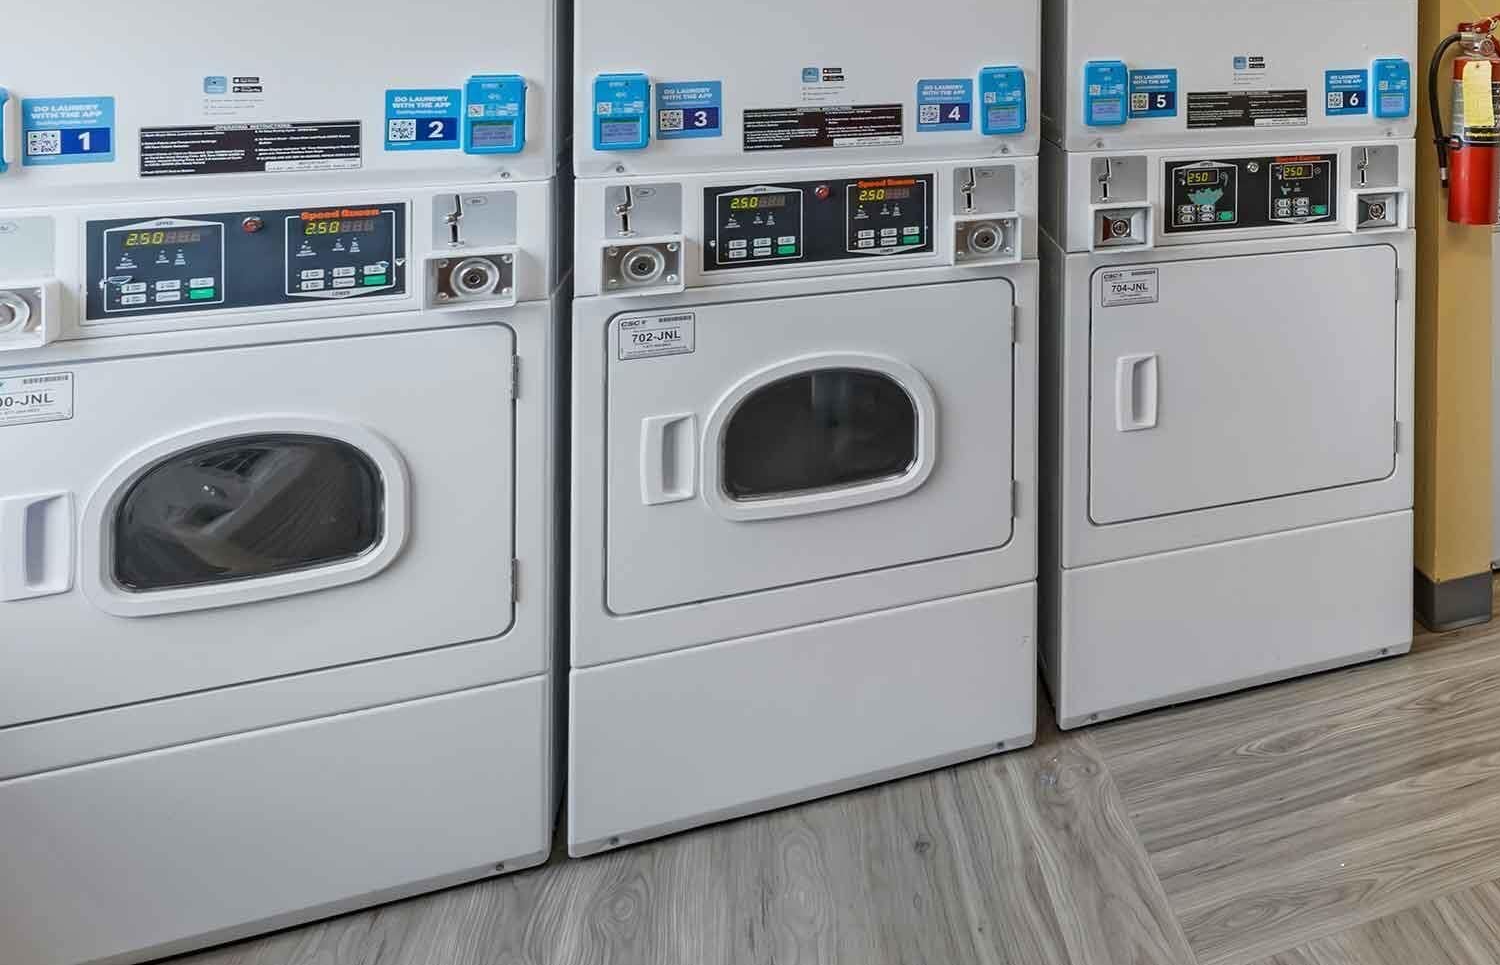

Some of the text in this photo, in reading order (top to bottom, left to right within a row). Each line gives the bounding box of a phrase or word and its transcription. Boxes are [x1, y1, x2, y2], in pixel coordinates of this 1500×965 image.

[408, 95, 449, 103] LAUNDRY
[1156, 94, 1167, 108] 5
[1349, 92, 1360, 106] 6
[31, 112, 59, 120] WITH
[82, 109, 103, 117] APP
[32, 103, 98, 113] DO LAUNDRY
[947, 106, 961, 121] 4
[694, 110, 708, 127] 3
[427, 120, 445, 139] 2
[78, 131, 91, 152] 1
[1111, 282, 1149, 293] 704-JNL
[631, 329, 681, 343] 702-JNL
